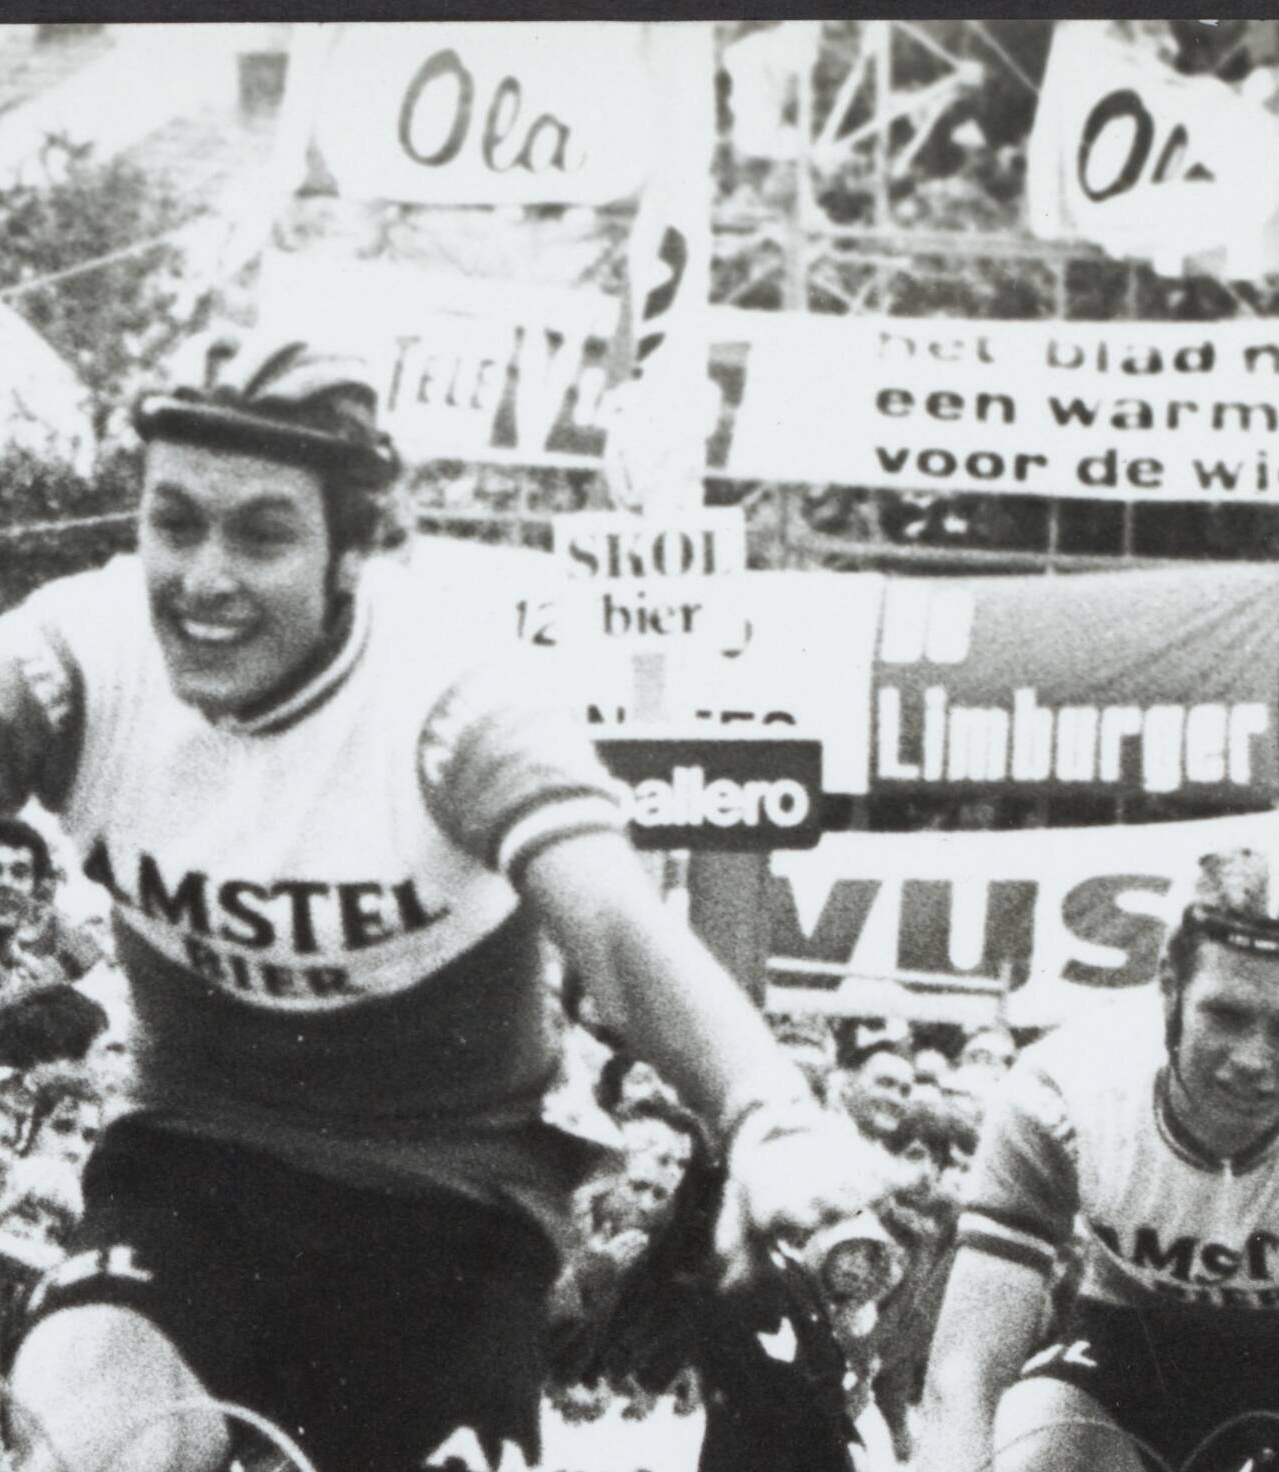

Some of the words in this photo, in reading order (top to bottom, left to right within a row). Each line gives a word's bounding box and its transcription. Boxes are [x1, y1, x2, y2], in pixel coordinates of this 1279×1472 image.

[398, 48, 574, 173] Ola
[874, 387, 1016, 424] een
[1047, 396, 1279, 432] warm
[874, 445, 1048, 482] voor
[1076, 448, 1164, 489] de
[602, 591, 702, 635] bier
[629, 766, 810, 828] allero
[83, 840, 452, 955] AMSTEL
